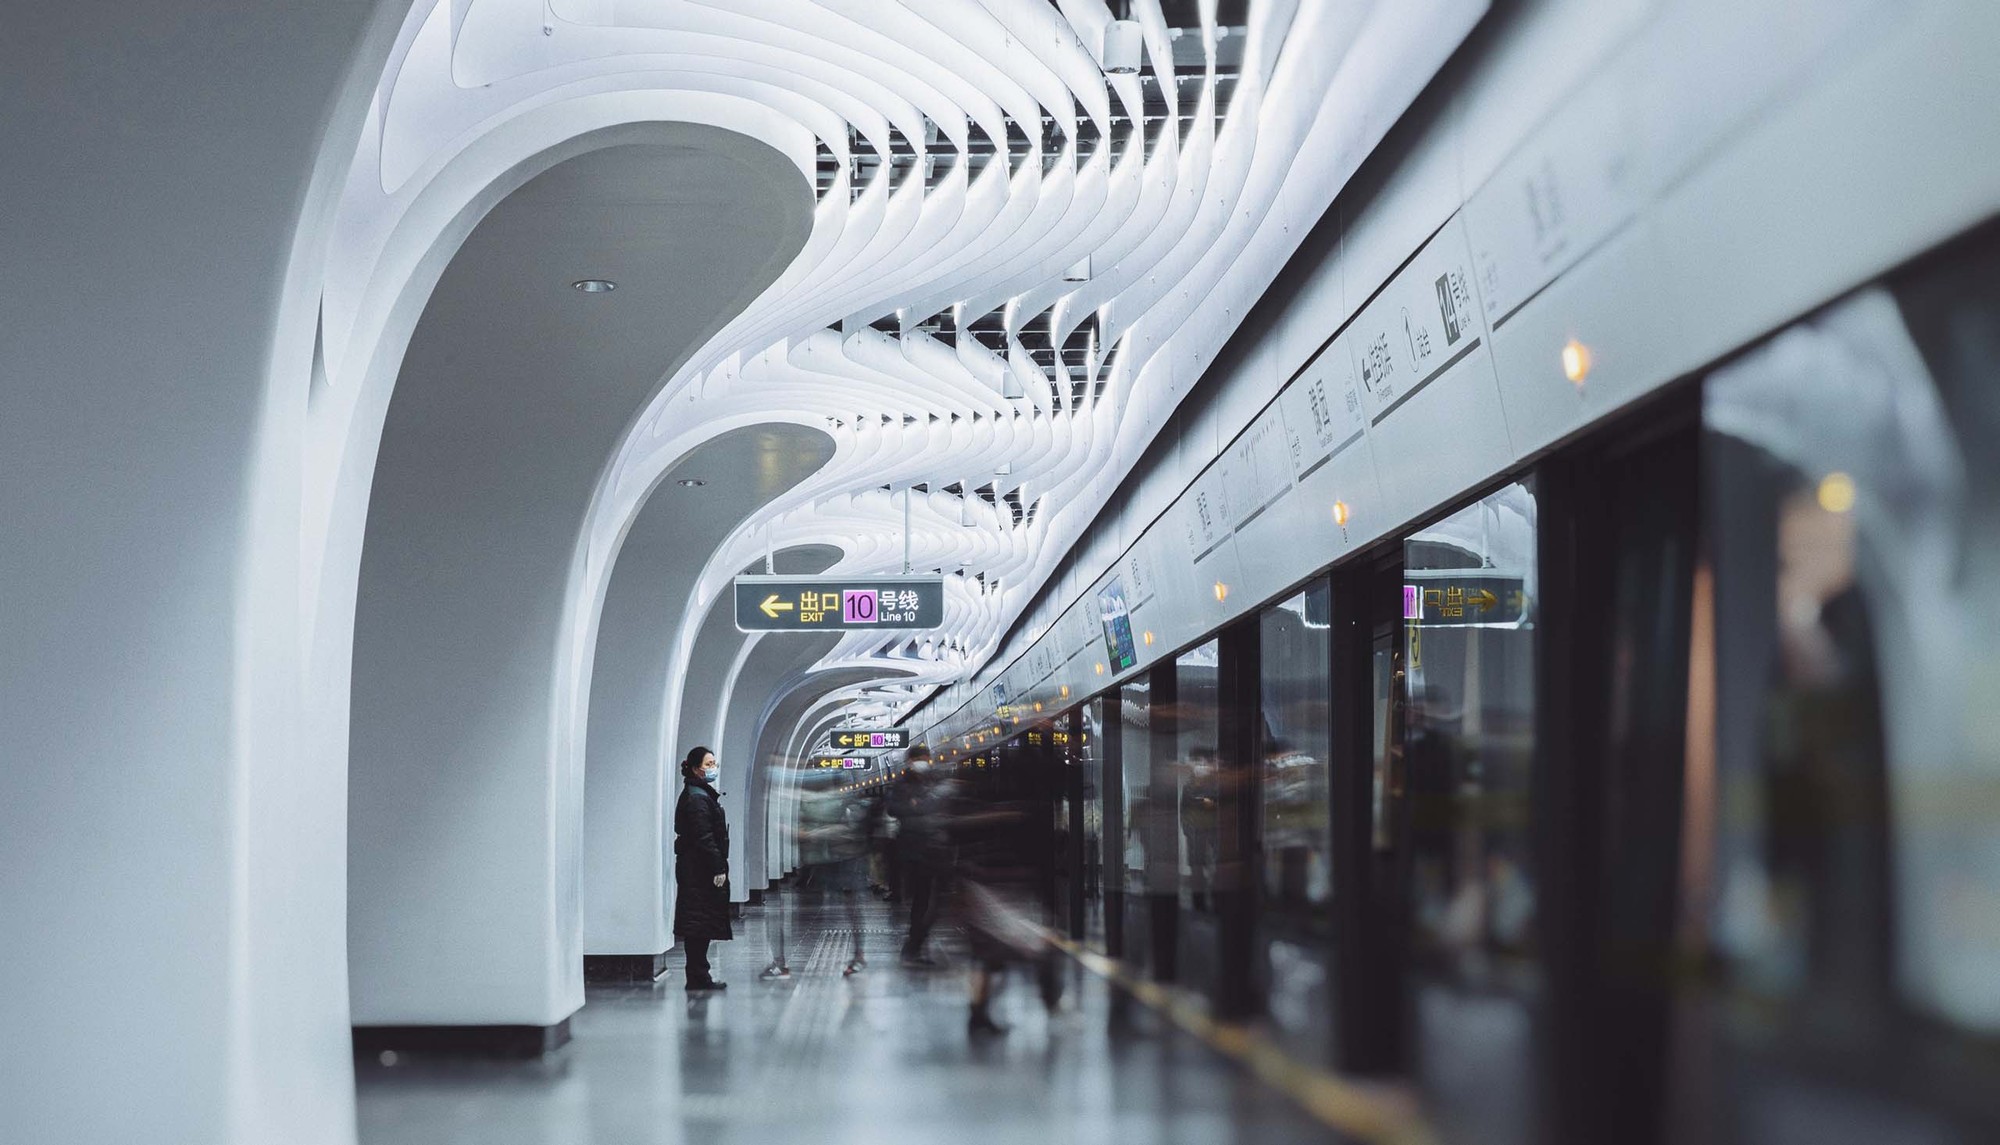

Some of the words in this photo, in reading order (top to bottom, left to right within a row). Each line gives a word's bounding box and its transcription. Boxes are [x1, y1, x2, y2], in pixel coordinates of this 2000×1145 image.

[1439, 280, 1457, 338] 14
[800, 591, 839, 611] 出口
[846, 594, 873, 619] 10
[879, 590, 919, 611] 号线
[800, 612, 825, 622] EXIT
[881, 612, 902, 622] Line
[903, 612, 916, 622] 10
[854, 733, 870, 743] 出口
[872, 734, 884, 745] 10
